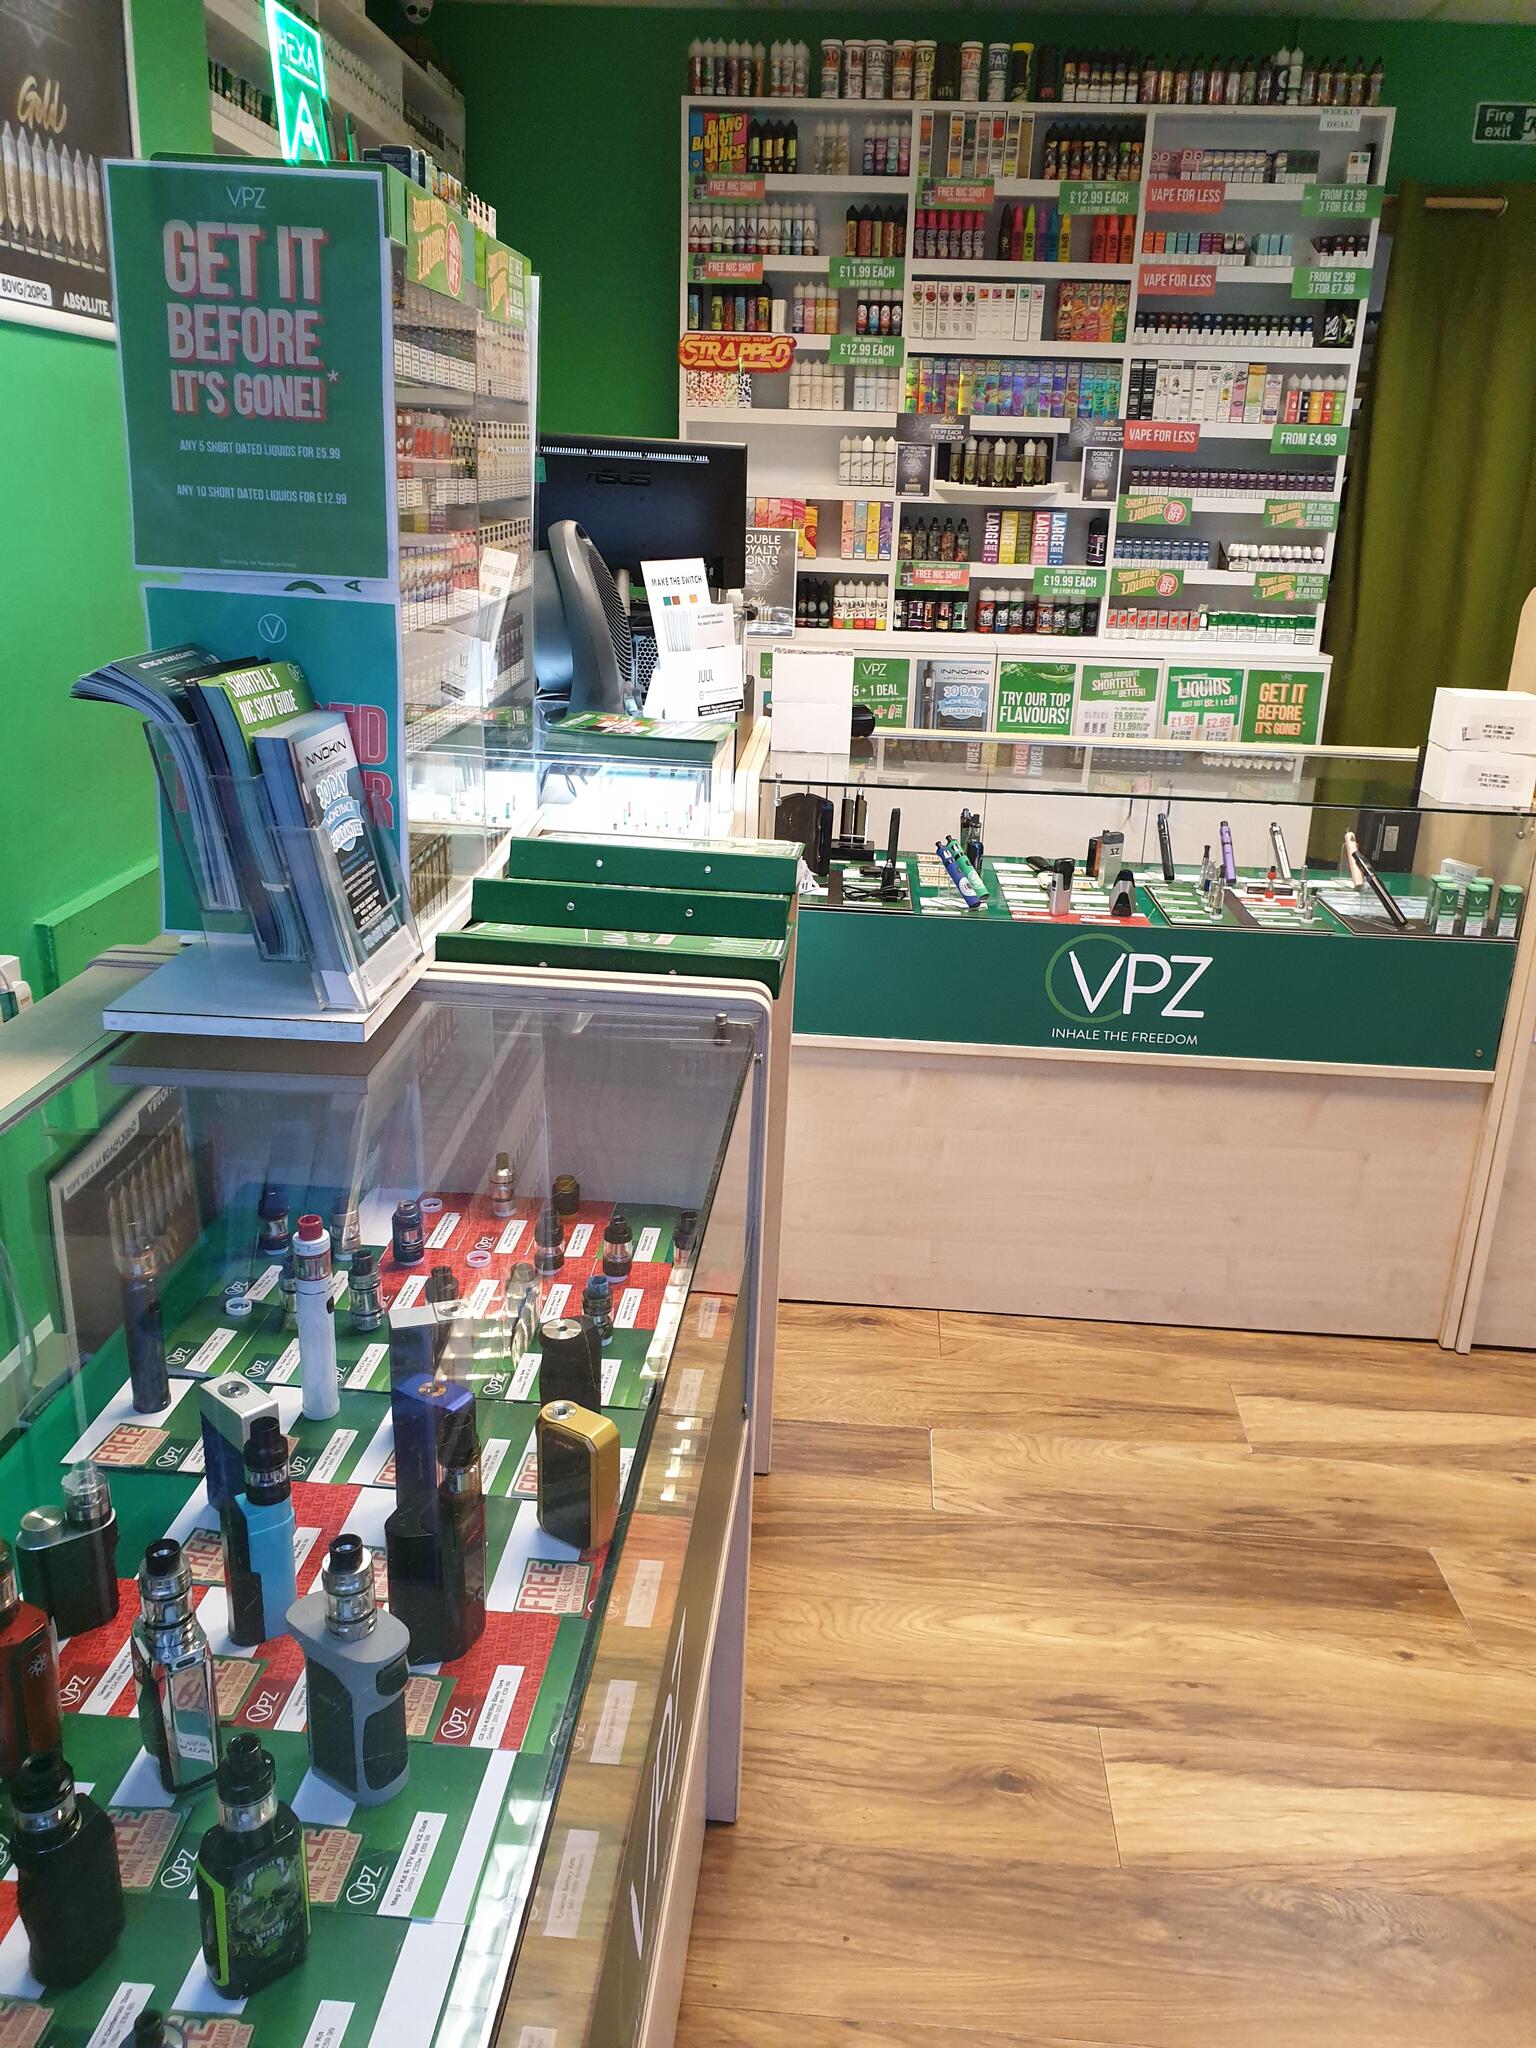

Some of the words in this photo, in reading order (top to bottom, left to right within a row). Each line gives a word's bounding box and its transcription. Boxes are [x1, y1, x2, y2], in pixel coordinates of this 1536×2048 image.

[1486, 108, 1515, 122] Fire
[1484, 124, 1511, 137] exit
[709, 180, 726, 191] FREE
[740, 181, 757, 191] SHOT
[937, 186, 954, 197] FREE
[226, 186, 266, 209] VPZ
[1070, 191, 1103, 204] £12.99
[1105, 191, 1129, 204] EACH
[1151, 188, 1175, 201] VAPE
[1178, 189, 1195, 202] FOR
[1198, 189, 1222, 203] LESS
[1320, 188, 1342, 200] FROM
[1343, 189, 1368, 201] £1.99
[1318, 202, 1324, 213] 3
[1325, 202, 1342, 213] FOR
[1342, 202, 1366, 213] £4.99
[163, 219, 264, 299] GET
[277, 226, 327, 304] IT
[708, 262, 725, 273] FREE
[725, 262, 737, 272] NIC
[738, 262, 756, 273] SHOT
[840, 265, 870, 278] £11.99
[872, 265, 895, 278] EACH
[1309, 271, 1331, 282] FROM
[1332, 272, 1356, 283] £2.99
[1143, 273, 1167, 287] VAPE
[1169, 274, 1187, 287] FOR
[1188, 274, 1212, 288] LESS
[1308, 283, 1314, 294] 3
[1314, 284, 1330, 294] FOR
[1330, 284, 1355, 295] £7.99
[167, 303, 323, 368] BEFORE
[680, 336, 791, 368] STRAPPED
[840, 343, 870, 356] £12.99
[872, 344, 895, 357] EACH
[170, 369, 228, 417] IT'S
[1129, 428, 1152, 442] VAPE
[1154, 430, 1171, 443] FOR
[1173, 430, 1196, 444] LESS
[1280, 432, 1307, 446] FROM
[1308, 433, 1337, 447] £4.99
[180, 439, 197, 451] ANY
[199, 440, 205, 452] 5
[206, 441, 233, 454] SHORT
[235, 443, 262, 455] DATED
[264, 444, 296, 457] LIQUIDS
[298, 446, 314, 458] FOR
[315, 447, 341, 459] £5.99
[177, 484, 194, 496] ANY
[196, 486, 207, 497] 10
[208, 487, 235, 499] SHORT
[237, 488, 264, 500] DATED
[266, 490, 298, 502] LIQUIDS
[299, 492, 315, 503] FOR
[317, 493, 347, 505] £12.99
[1128, 504, 1164, 522] LIQUIDS
[1167, 511, 1182, 522] OFF
[984, 512, 1000, 545] LARGE
[1035, 514, 1050, 546] LARGE
[1052, 514, 1067, 547] LARGE
[746, 535, 781, 545] OUBLE
[746, 556, 778, 565] OINTS
[651, 577, 669, 587] MAKE
[670, 576, 681, 586] THE
[682, 575, 703, 585] SWITCH
[915, 569, 933, 579] FREE
[934, 570, 945, 580] NIC
[946, 570, 962, 580] SHOT
[1043, 575, 1073, 588] £19.99
[1075, 576, 1097, 588] EACH
[1159, 583, 1174, 593] OFF
[698, 669, 714, 683] JUUL
[862, 663, 887, 676] VPZ
[941, 668, 989, 676] INNOKIN
[1056, 664, 1069, 673] VPZ
[225, 668, 274, 698] SHORTFILL
[269, 667, 280, 689] &
[853, 685, 860, 697] 5
[877, 683, 899, 696] DEAL
[1092, 677, 1139, 691] SHORTFILL
[1177, 677, 1232, 698] LIQUIDS
[943, 684, 957, 698] 30
[959, 685, 983, 698] DAY
[1119, 688, 1146, 697] BETTER!
[1259, 682, 1290, 704] GET
[1291, 683, 1308, 704] IT
[239, 698, 259, 725] NIC
[255, 693, 277, 720] SHOT
[274, 689, 298, 716] GUIDE
[1002, 692, 1022, 705] TRY
[1025, 692, 1047, 706] OUR
[1050, 693, 1071, 708] TOP
[1204, 695, 1238, 707] BETTER!
[895, 704, 903, 718] FREE
[942, 706, 983, 717] GUARANTEE
[1000, 707, 1069, 724] FLAVOURS!
[1114, 711, 1133, 720] £9.99
[1257, 704, 1303, 721] BEFORE
[1113, 722, 1136, 731] £11.99
[1171, 715, 1195, 727] £1.99
[1206, 716, 1231, 729] £2.99
[1255, 721, 1273, 735] IT'S
[304, 739, 347, 768] INNOKIN
[328, 771, 349, 803] DAY
[1069, 951, 1213, 1018] VPZ
[1051, 1028, 1100, 1041] INHALE
[1104, 1030, 1128, 1042] THE
[1131, 1031, 1198, 1046] FREEDOM
[165, 1346, 191, 1366] VPZ
[245, 1359, 270, 1379] VPZ
[482, 1372, 506, 1396] VPZ
[93, 1425, 148, 1463] FREE
[156, 1446, 184, 1468] VPZ
[560, 1564, 578, 1592] E-LIQUID
[518, 1562, 564, 1611] FREE
[554, 1592, 568, 1612] 10ML
[58, 1675, 91, 1708] VPZ
[246, 1690, 279, 1723] VPZ
[441, 1707, 470, 1738] VPZ
[317, 1832, 347, 1872] E-LIQUID
[340, 1836, 361, 1861] DEVICE
[161, 1848, 199, 1888] VPZ
[391, 1892, 401, 1906] Mag
[418, 1820, 428, 1834] Tank
[346, 1865, 382, 1904] VPZ
